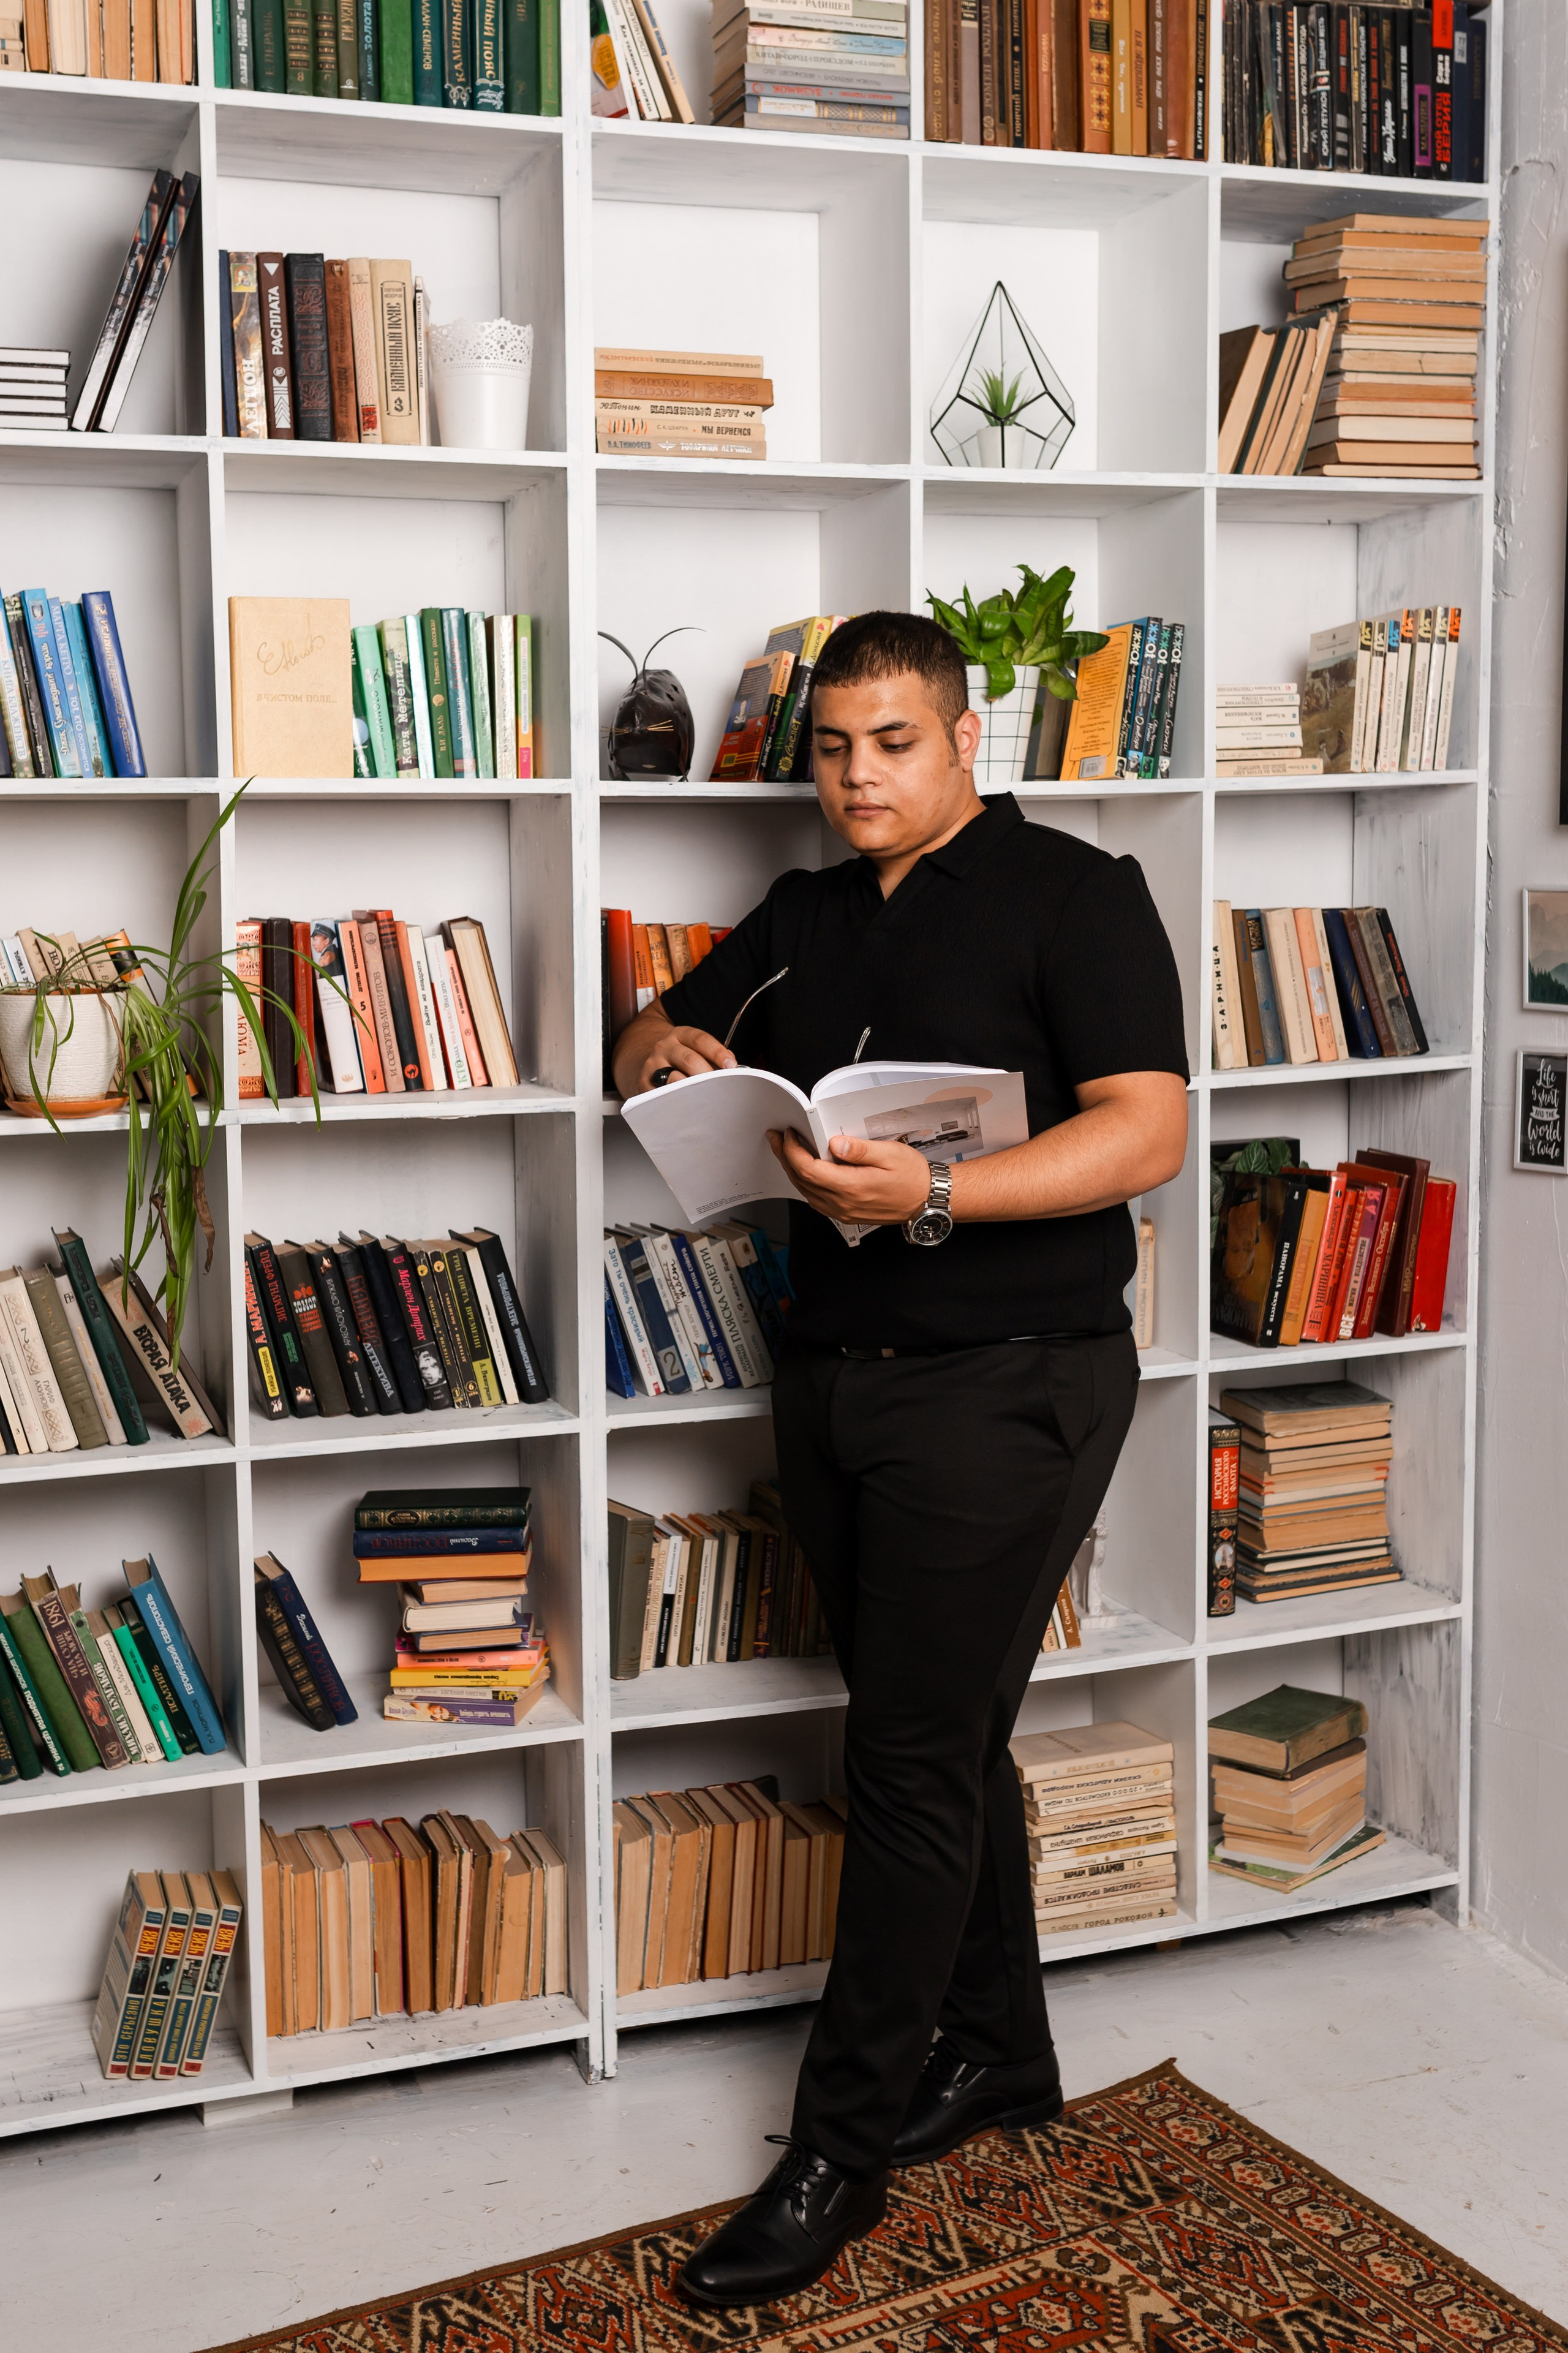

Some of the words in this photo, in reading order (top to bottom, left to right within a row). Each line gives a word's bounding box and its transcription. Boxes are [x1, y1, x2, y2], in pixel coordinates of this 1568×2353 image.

[982, 5, 993, 58] РОЛЛАН
[483, 40, 496, 79] ПОЯС
[983, 64, 993, 108] РОМЕН
[1442, 92, 1451, 164] БЕРИЯ
[272, 285, 284, 355] РАСПЛАТА
[386, 302, 402, 330] ПОЯС
[387, 331, 405, 392] КАМЕННЫЙ
[701, 425, 714, 434] МЫ
[715, 426, 752, 436] ВЕРНЕМСЯ
[51, 605, 66, 641] МАРТА
[58, 641, 73, 675] КЕТРО
[263, 694, 303, 703] ЧИСТОМ
[394, 651, 409, 723] Метелица
[401, 730, 412, 765] Катя
[417, 960, 426, 991] квадрата
[360, 1001, 366, 1011] 5
[374, 971, 396, 1066] СОКОЛОВ-МИКИТОВ
[1536, 1058, 1556, 1088] Life
[1531, 1086, 1538, 1101] is
[1538, 1088, 1559, 1107] short
[1534, 1108, 1545, 1119] AND
[1546, 1109, 1556, 1119] THE
[1529, 1141, 1536, 1158] is
[1325, 1202, 1340, 1250] Александра
[262, 1248, 277, 1280] ФРЕЙД
[699, 1247, 722, 1294] СМЕРТИ
[1275, 1241, 1290, 1289] ПАНОРАМА
[1368, 1256, 1382, 1293] Великого
[1376, 1221, 1389, 1255] Октября
[496, 1272, 519, 1326] ЭЛЕКТРОПРИВОД
[608, 1248, 619, 1267] Зато
[614, 1269, 622, 1280] ты
[619, 1282, 630, 1305] очень
[625, 1305, 645, 1344] красивый
[1314, 1252, 1333, 1310] МАРИНИНА
[268, 1281, 288, 1322] ЗИГМУНД
[397, 1268, 417, 1302] Марлен
[407, 1301, 426, 1342] Дитрих
[458, 1272, 470, 1305] ЦВЕТА
[464, 1305, 482, 1350] ВРЕМЕНИ
[718, 1295, 741, 1343] ПЛЯСКА
[1339, 1313, 1355, 1337] ВСЕ
[132, 1323, 170, 1372] ВТОРАЯ
[159, 1372, 192, 1415] АТАКА
[362, 1342, 395, 1399] ДЕТЕКТИВА
[663, 1351, 680, 1377] 2
[1214, 1457, 1223, 1500] ИСТОРИЯ
[42, 1600, 66, 1629] 1981
[94, 1661, 121, 1712] БУЛГАКОВ
[116, 1713, 139, 1756] МИХАИЛ
[1063, 1869, 1086, 1879] ВАРЛАМ
[1088, 1862, 1125, 1876] ШАЛАМОВ
[1102, 1881, 1142, 1894] СЛЕДСТВИЕ
[1044, 1888, 1101, 1904] ПРОДОЛЖАЕТСЯ
[1084, 1918, 1110, 1928] ГОРОД
[1114, 1911, 1153, 1925] РОКОВОЙ
[138, 1930, 159, 1954] ЧЕЙЗ
[164, 1930, 185, 1954] ЧЕЙЗ
[188, 1931, 208, 1955] ЧЕЙЗ
[214, 1928, 235, 1951] ЧЕЙЗ
[120, 1999, 141, 2041] СЕРЬЕЗНО
[139, 2001, 167, 2061] ЛОВУШКА
[115, 2043, 129, 2060] ЭТО
